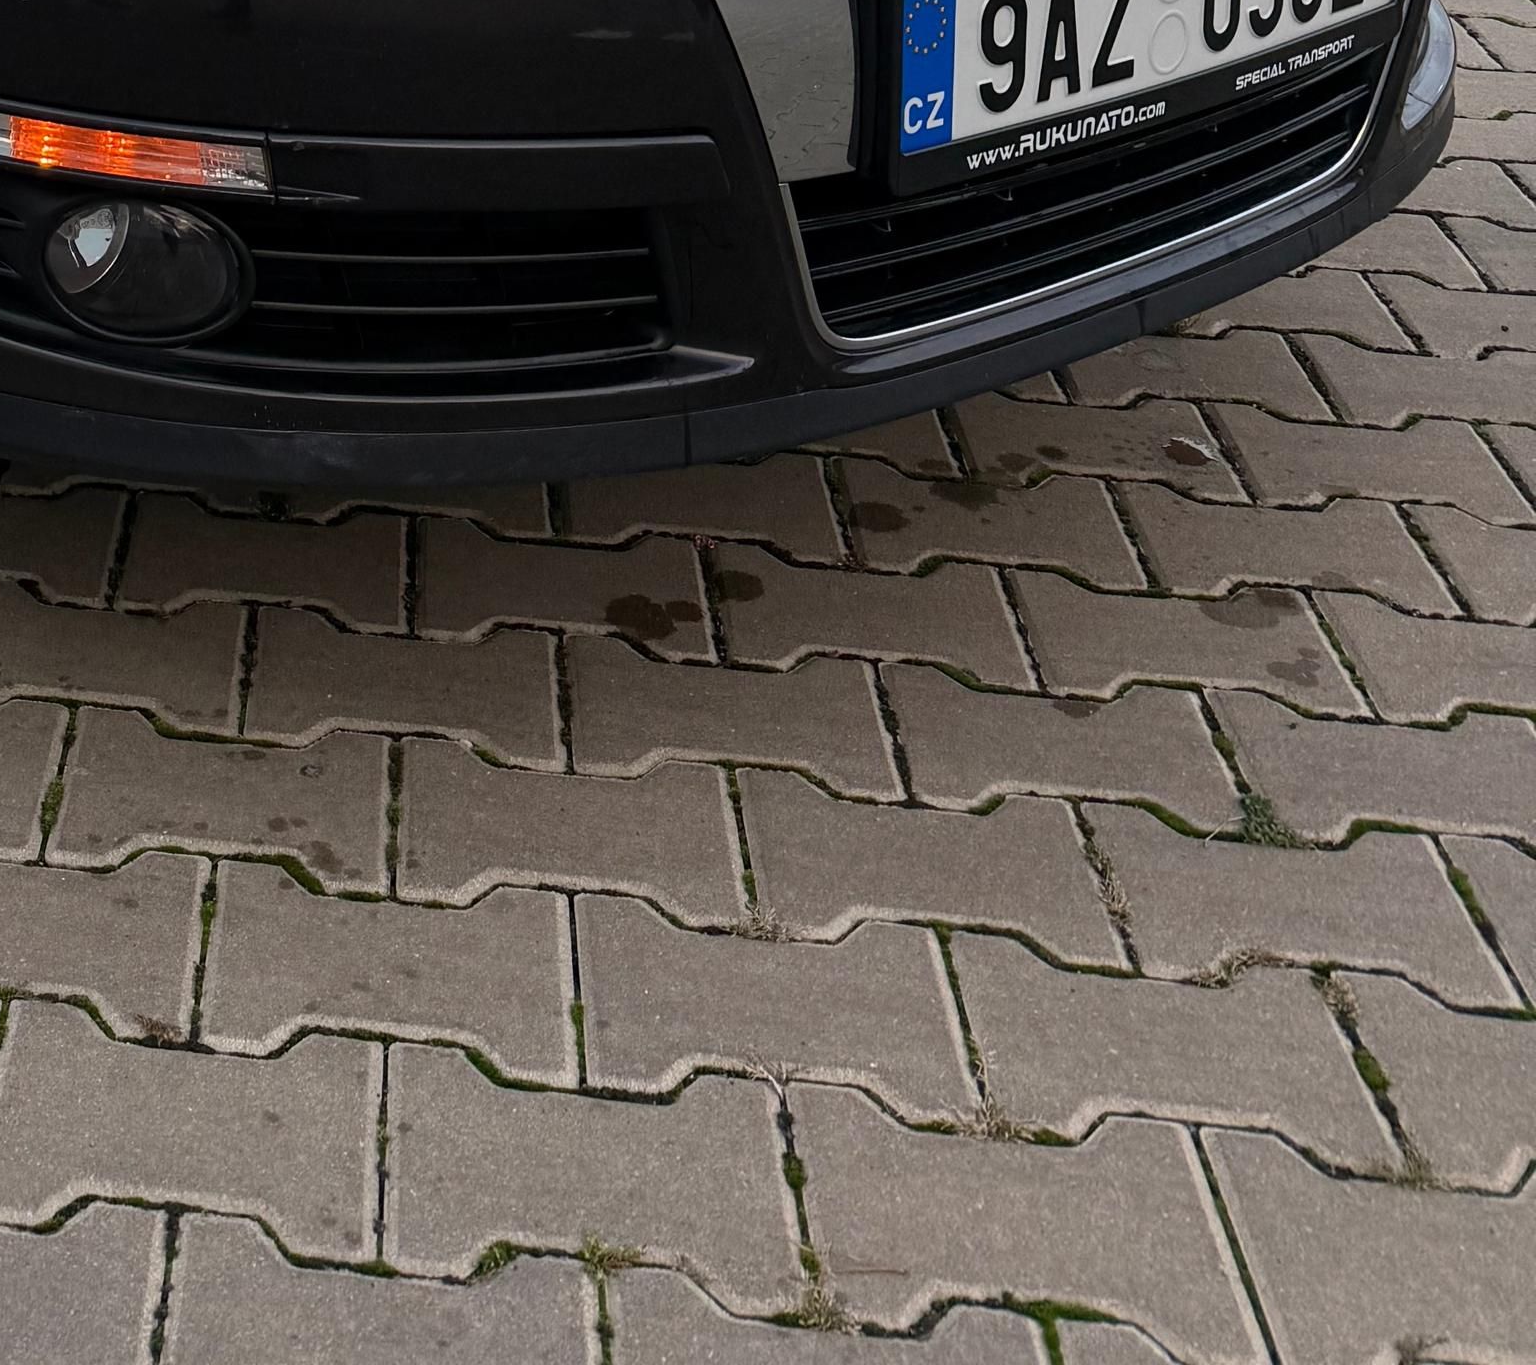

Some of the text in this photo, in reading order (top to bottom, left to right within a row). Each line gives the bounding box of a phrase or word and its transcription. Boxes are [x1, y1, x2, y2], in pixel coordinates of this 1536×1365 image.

[1234, 34, 1356, 91] SPECIAL TRANSPORT
[902, 90, 946, 135] CZ
